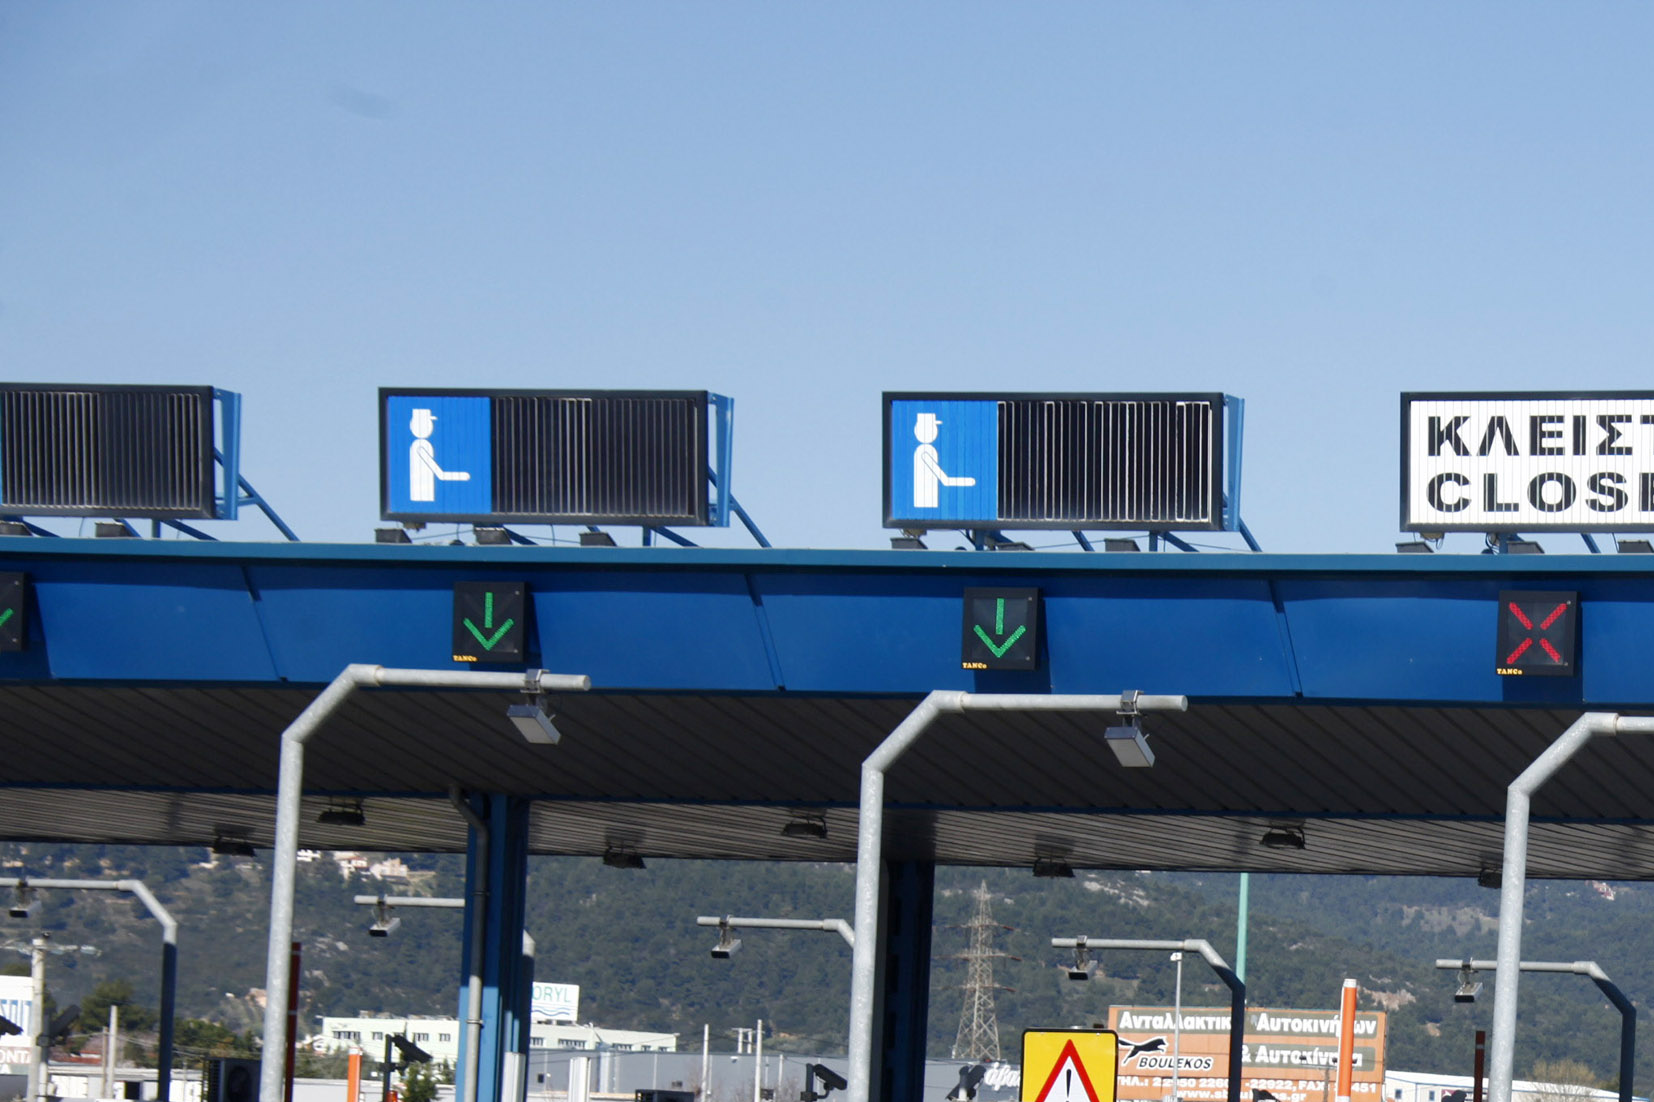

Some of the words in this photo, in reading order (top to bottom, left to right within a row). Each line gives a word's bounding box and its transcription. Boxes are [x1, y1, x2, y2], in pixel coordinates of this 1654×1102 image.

[1119, 1011, 1232, 1030] Ανταλλακτικ
[1256, 1012, 1377, 1037] Αυτοκινήων
[1138, 1056, 1213, 1069] BOULEKOS
